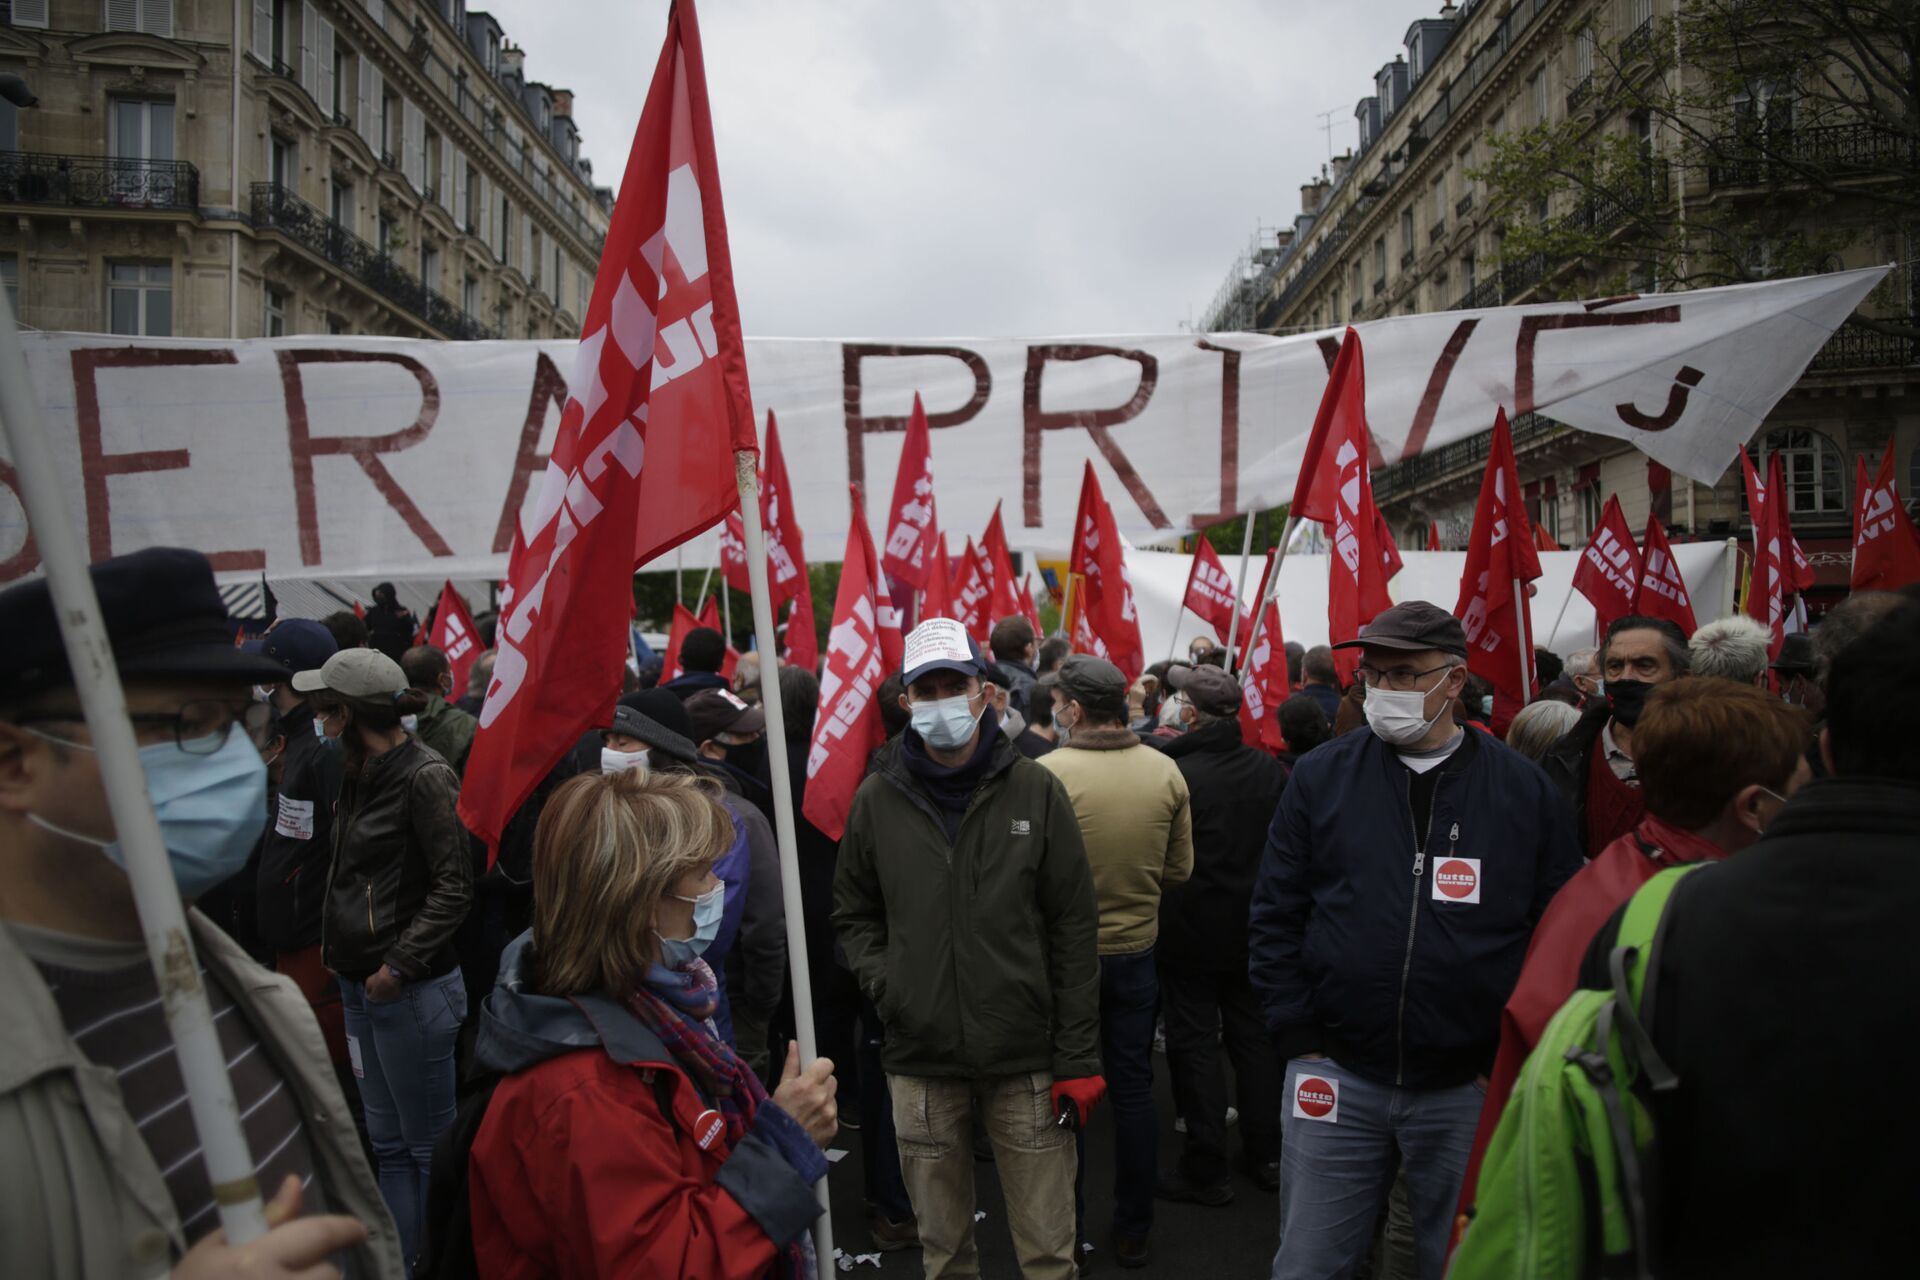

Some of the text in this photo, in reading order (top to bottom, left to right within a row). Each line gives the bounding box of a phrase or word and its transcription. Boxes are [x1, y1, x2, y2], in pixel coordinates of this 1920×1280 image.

[0, 347, 577, 583] ERA
[1438, 872, 1474, 881] lutte
[1299, 1090, 1333, 1101] lutte
